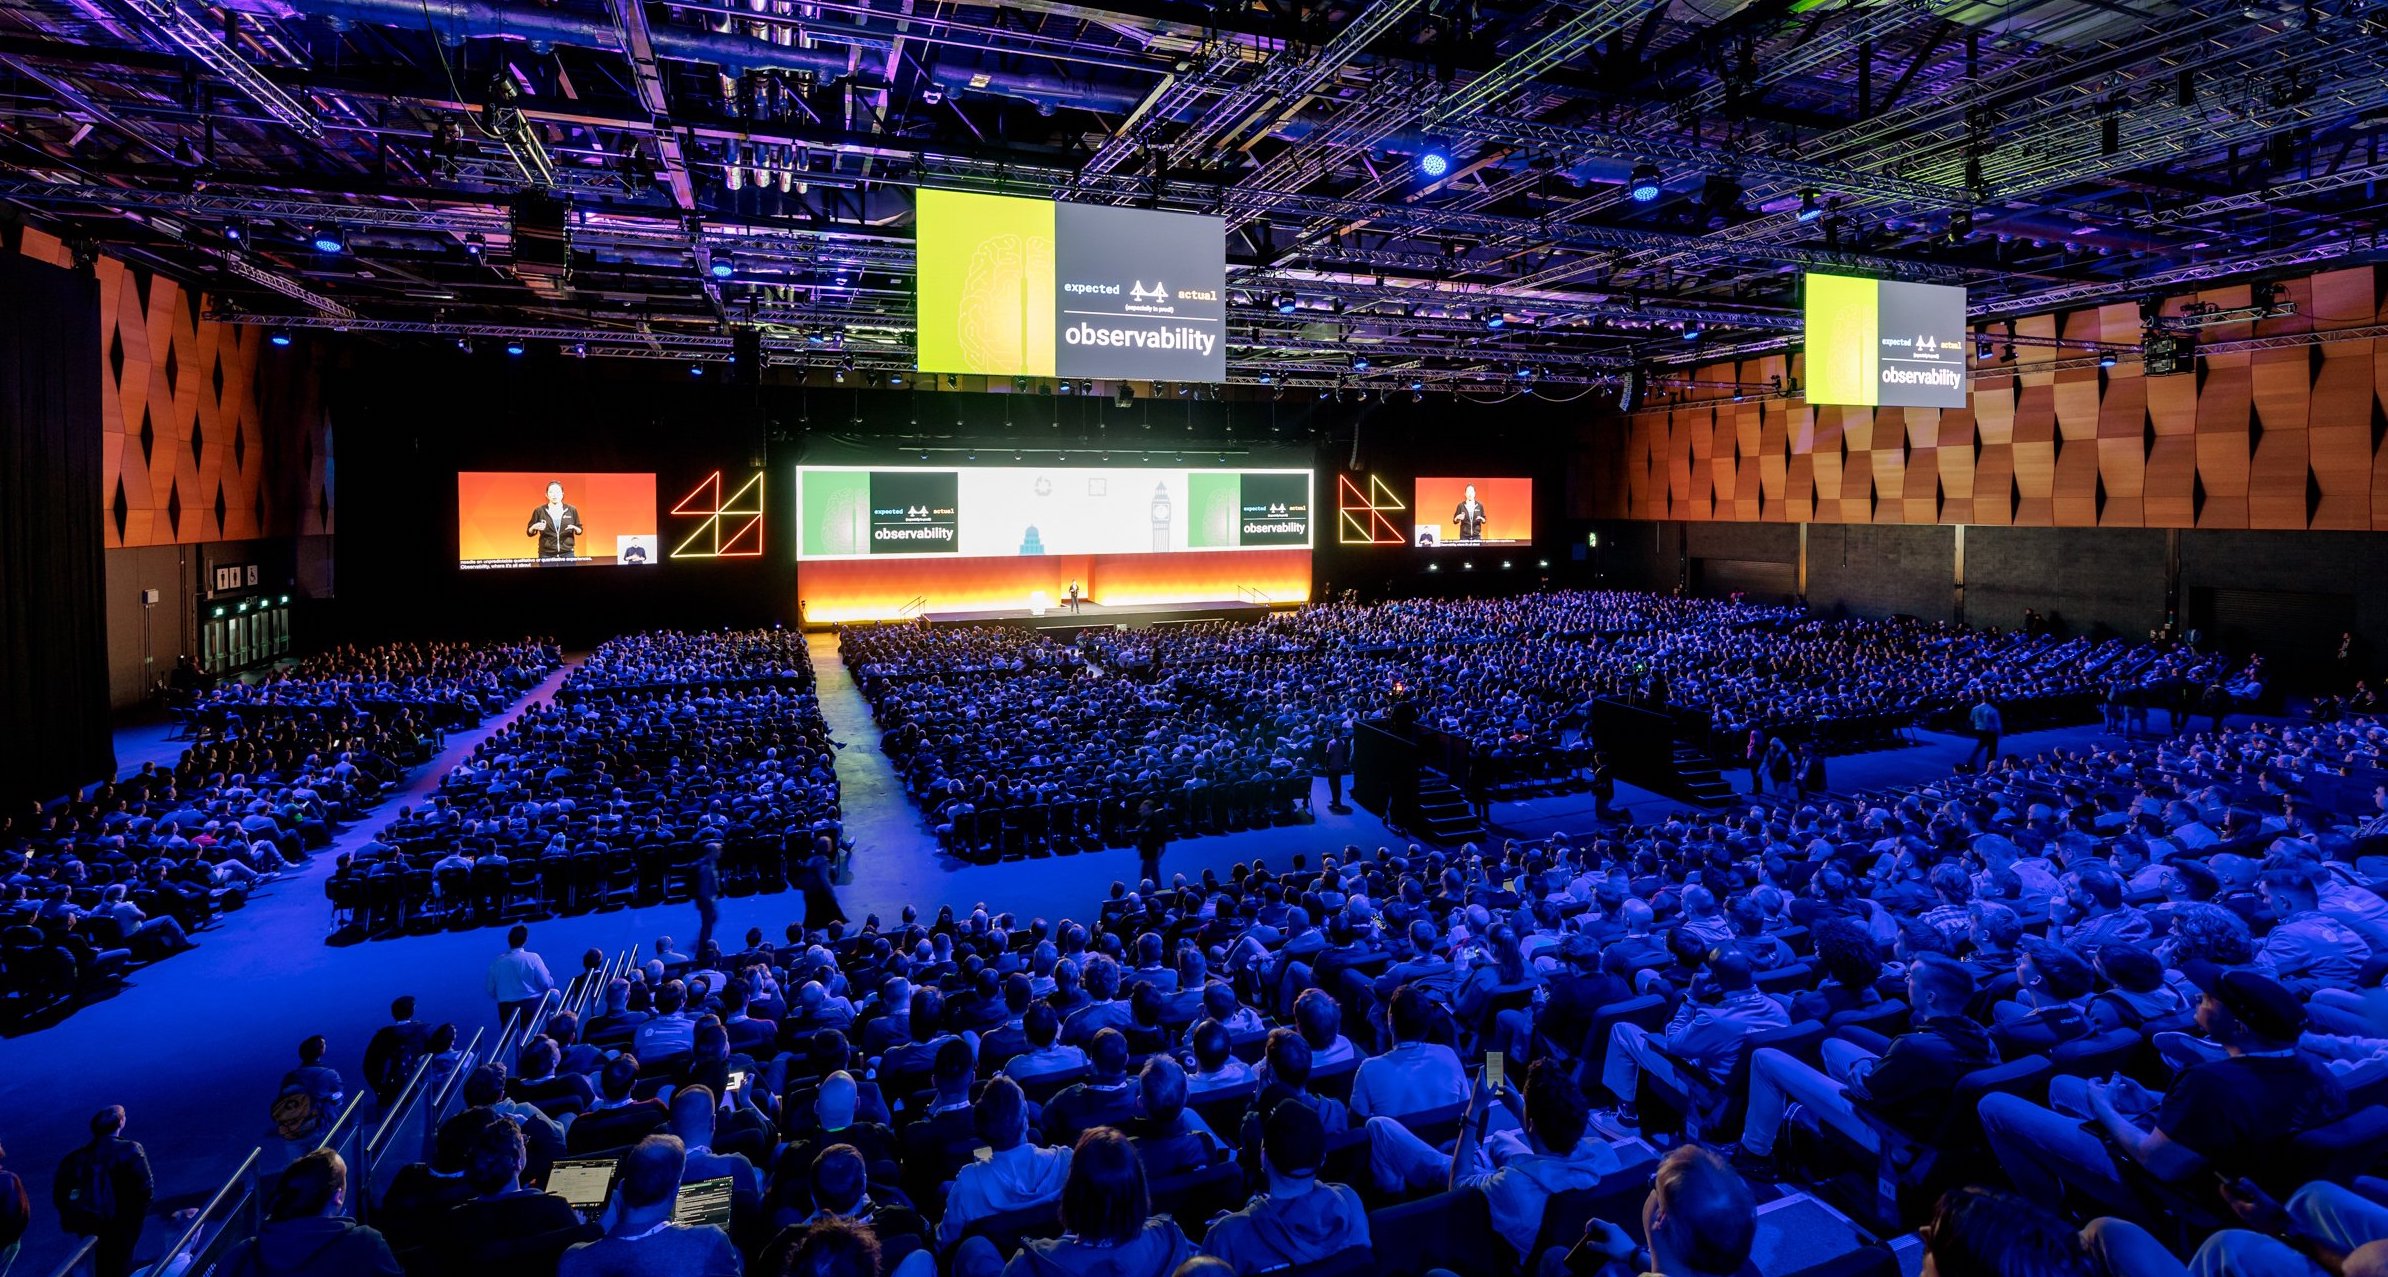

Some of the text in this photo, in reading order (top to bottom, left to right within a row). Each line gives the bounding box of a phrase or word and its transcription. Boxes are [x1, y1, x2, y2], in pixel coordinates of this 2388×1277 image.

[1064, 282, 1217, 301] expected actual
[1065, 322, 1216, 356] observability
[1882, 338, 1962, 350] expected actual
[1882, 366, 1961, 389] observability
[875, 527, 954, 541] observability
[1244, 522, 1305, 535] observability
[245, 595, 258, 605] EXIT
